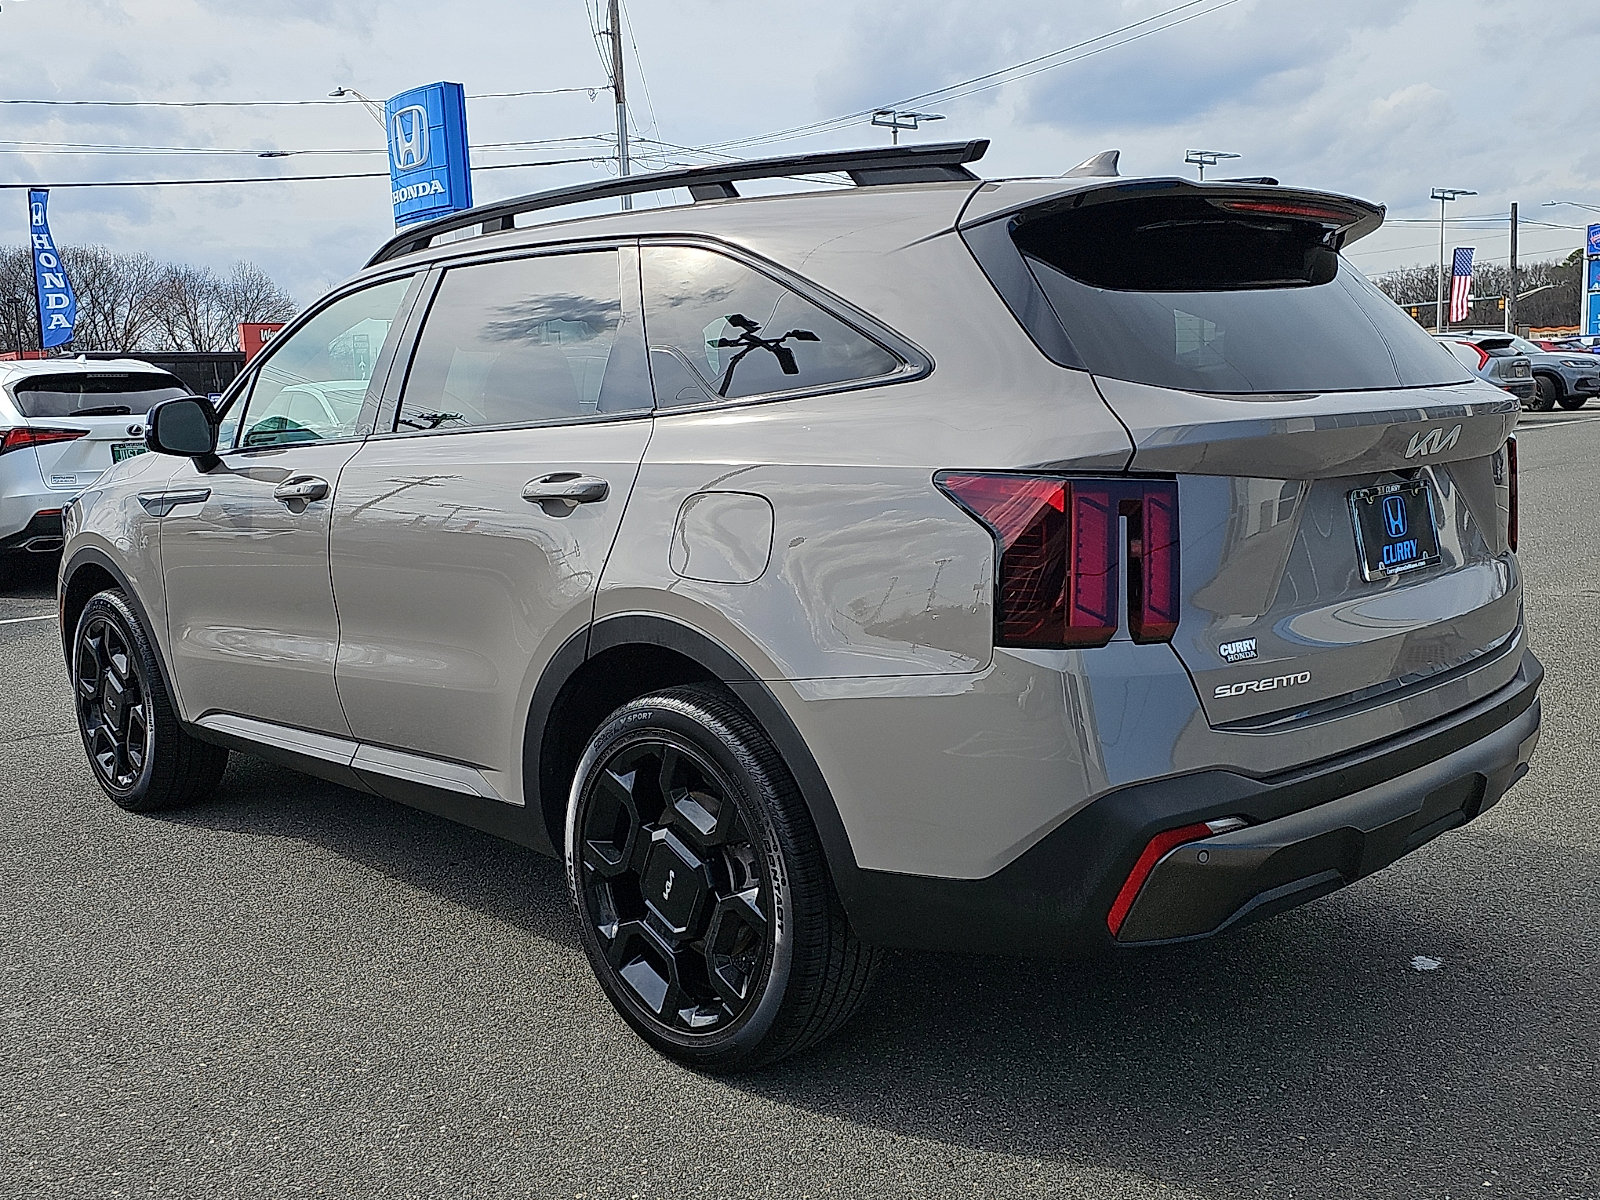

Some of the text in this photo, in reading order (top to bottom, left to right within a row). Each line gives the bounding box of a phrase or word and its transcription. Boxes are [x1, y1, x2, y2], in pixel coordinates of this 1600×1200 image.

[391, 179, 446, 205] HONDA
[31, 233, 73, 330] HONDA
[1383, 539, 1418, 565] CURRY
[1220, 638, 1257, 656] CURRY
[1226, 650, 1258, 663] HONDA
[1213, 671, 1311, 698] SORENTO
[627, 711, 653, 723] SPORT
